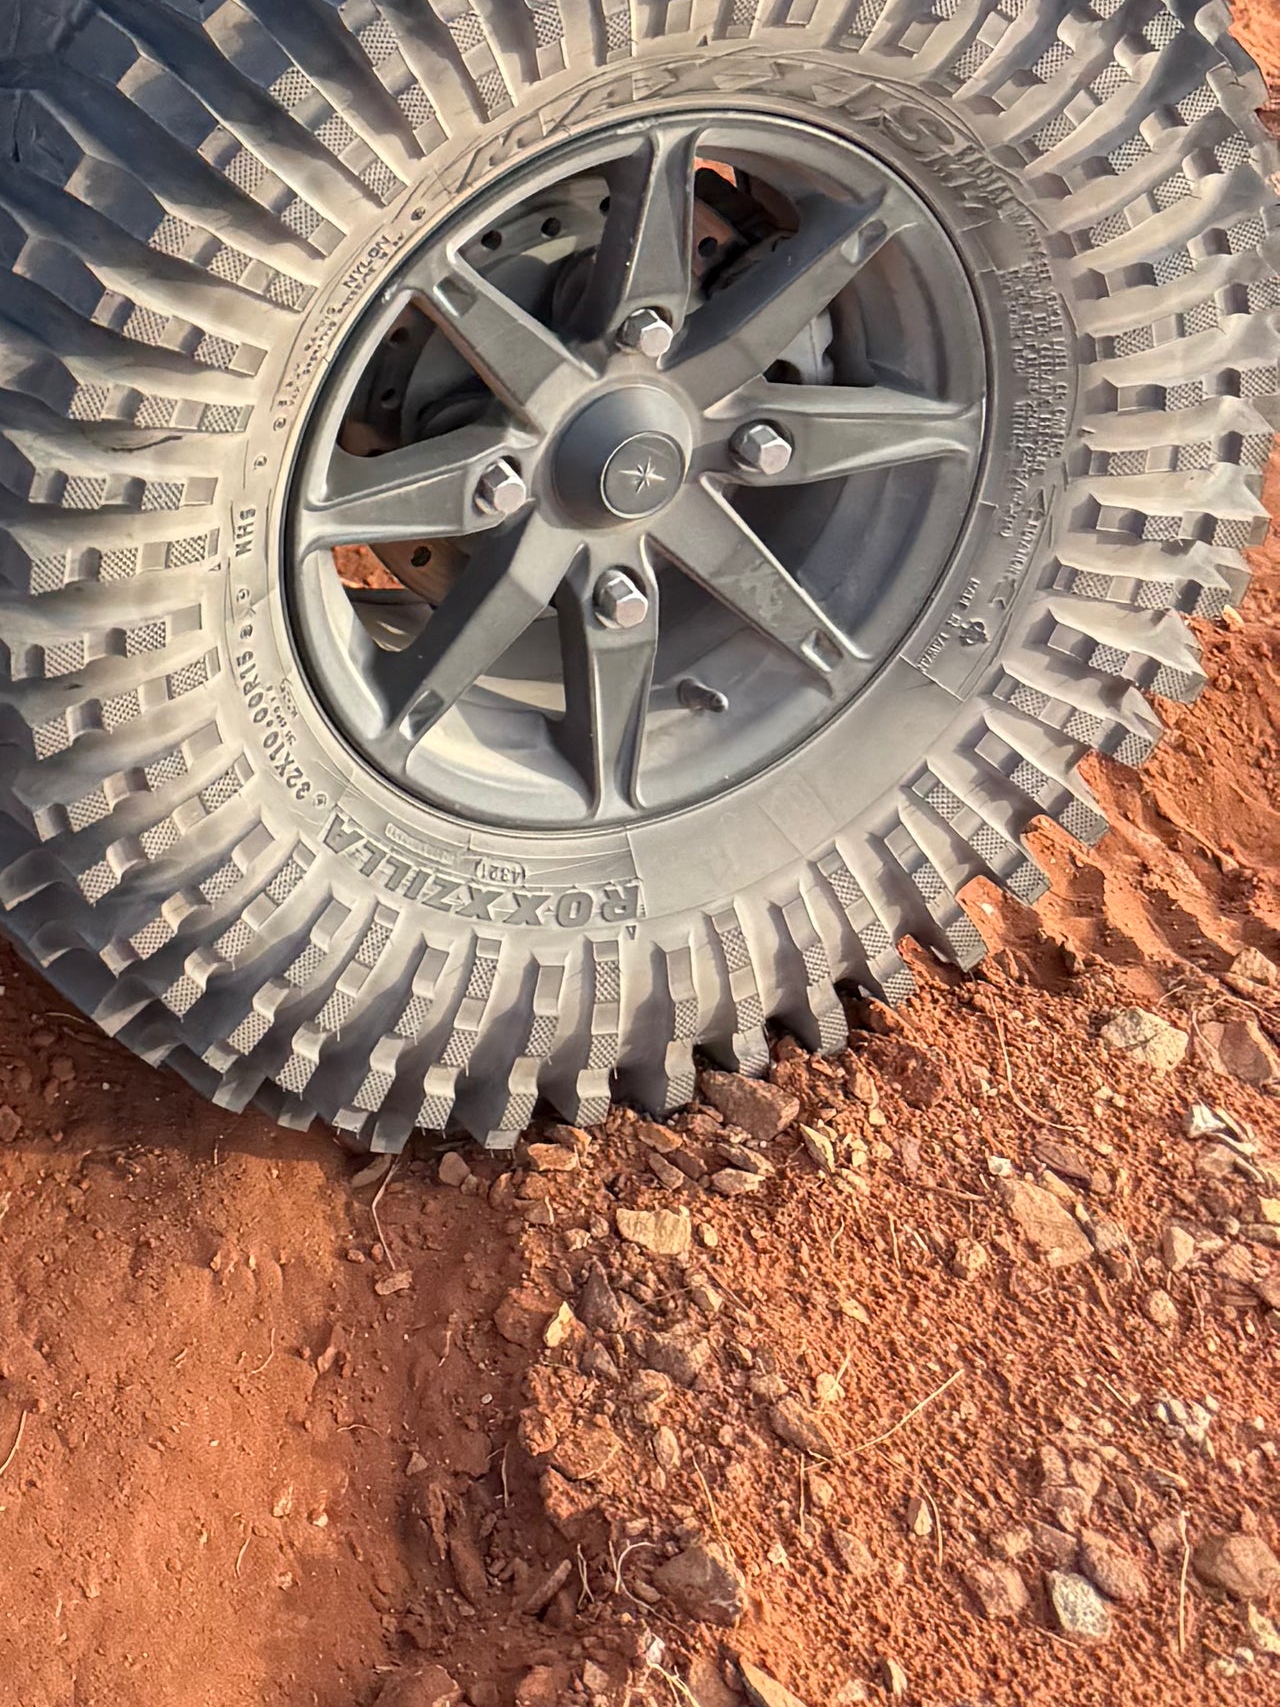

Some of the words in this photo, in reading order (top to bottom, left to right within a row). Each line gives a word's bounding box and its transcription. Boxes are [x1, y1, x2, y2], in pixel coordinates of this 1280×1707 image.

[342, 234, 390, 290] NYLON
[235, 508, 255, 556] NHS
[233, 649, 311, 800] 32X10.00R15
[320, 813, 646, 927] ROXXZILLA
[477, 861, 521, 885] 4321
